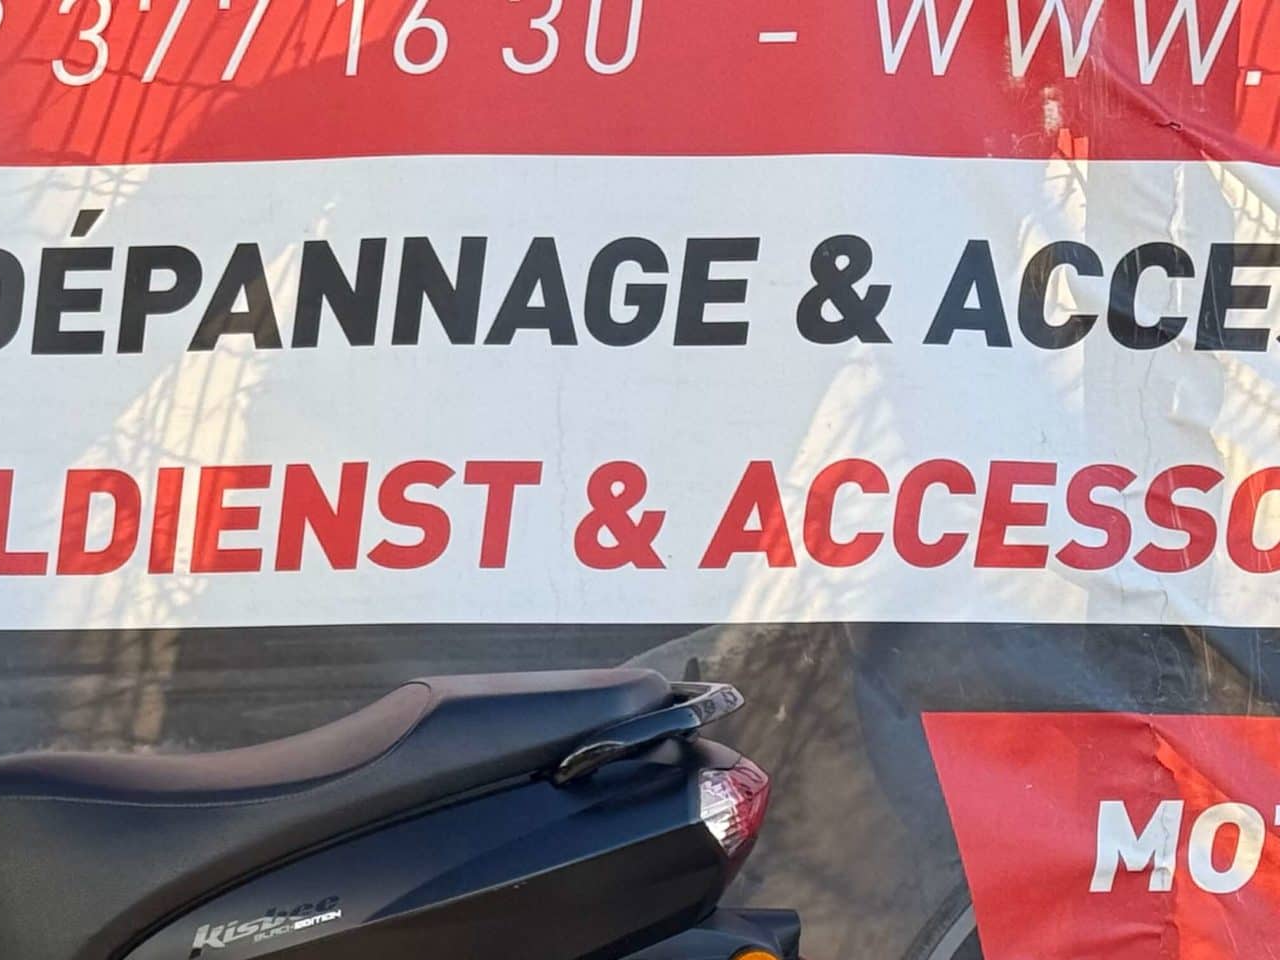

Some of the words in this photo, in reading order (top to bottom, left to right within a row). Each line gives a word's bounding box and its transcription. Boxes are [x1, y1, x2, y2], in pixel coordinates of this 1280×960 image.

[51, 0, 272, 87] 377
[336, 0, 449, 76] 16
[502, 0, 642, 75] 30
[795, 234, 892, 345] &
[923, 238, 1280, 353] ACCE
[574, 460, 667, 570] &
[1089, 799, 1280, 895] MO
